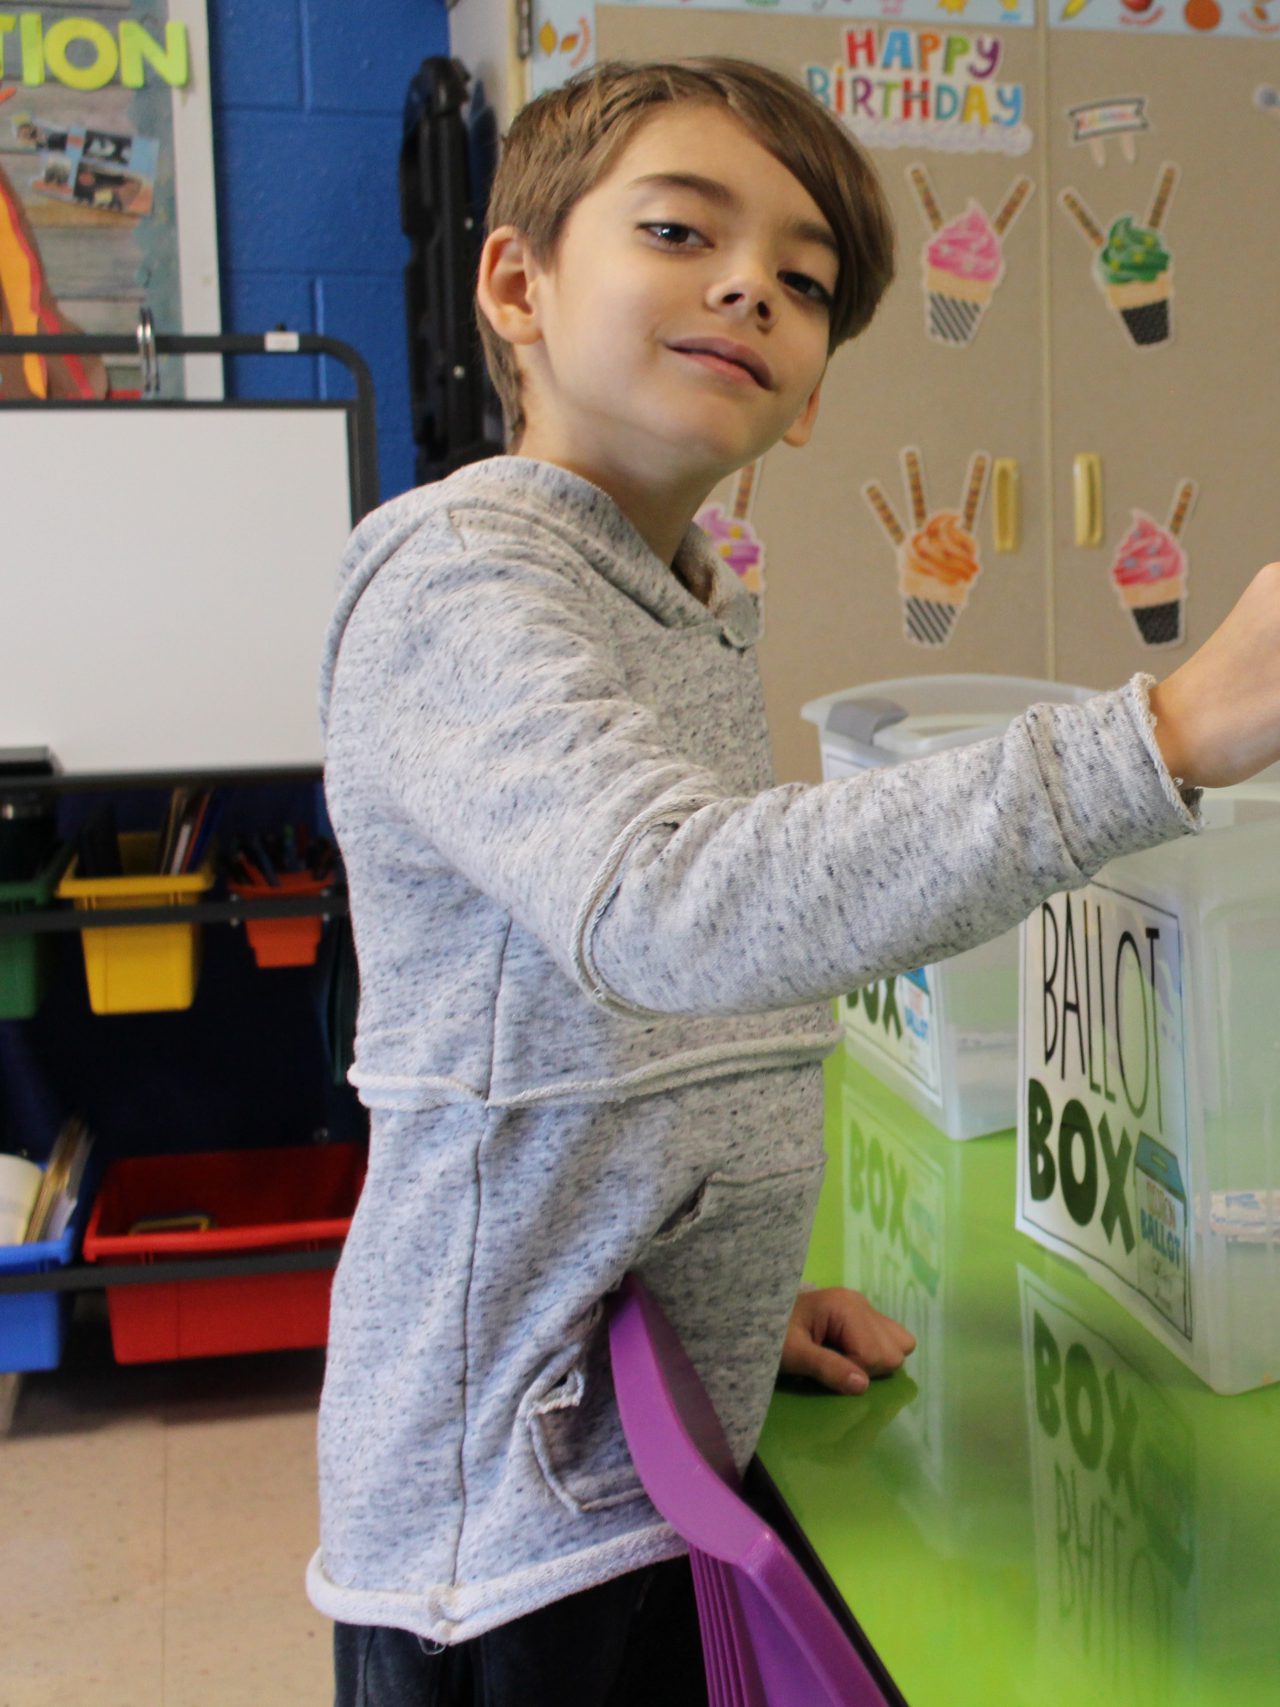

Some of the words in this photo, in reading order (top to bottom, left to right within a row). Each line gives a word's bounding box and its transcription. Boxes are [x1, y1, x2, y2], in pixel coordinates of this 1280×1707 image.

[847, 29, 1001, 78] HAPPY
[1043, 892, 1163, 1134] BALLOT
[1028, 1078, 1135, 1256] BOX
